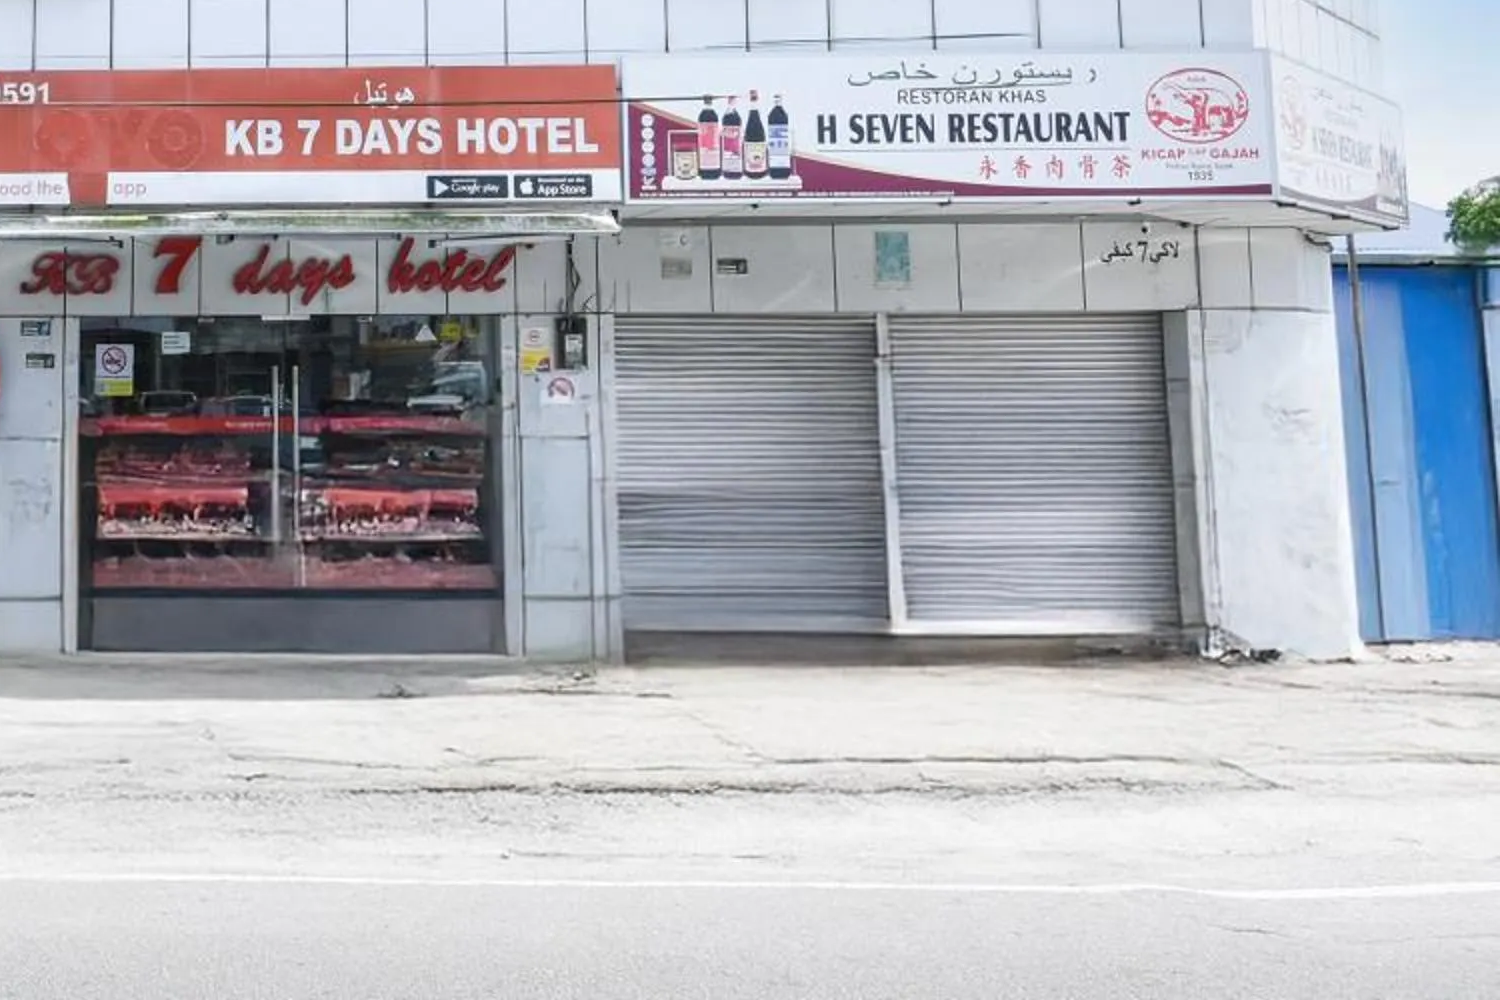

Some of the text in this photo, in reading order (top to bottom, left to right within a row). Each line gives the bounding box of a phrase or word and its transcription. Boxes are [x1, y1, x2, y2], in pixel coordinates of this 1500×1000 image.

[896, 88, 1048, 106] RESTORAN KHAS
[224, 119, 285, 157] KB
[298, 119, 322, 157] 7
[335, 118, 444, 156] DAYS
[456, 117, 600, 155] HOTEL
[816, 111, 1131, 146] H SEVEN RESTAURANT
[1141, 148, 1186, 161] KICAP
[1209, 147, 1260, 160] GAJAH
[37, 180, 63, 196] the
[113, 182, 148, 197] app
[451, 183, 481, 195] Google
[537, 183, 587, 196] App Store
[153, 237, 200, 295] 7
[233, 244, 355, 304] days
[389, 238, 517, 296] hotel
